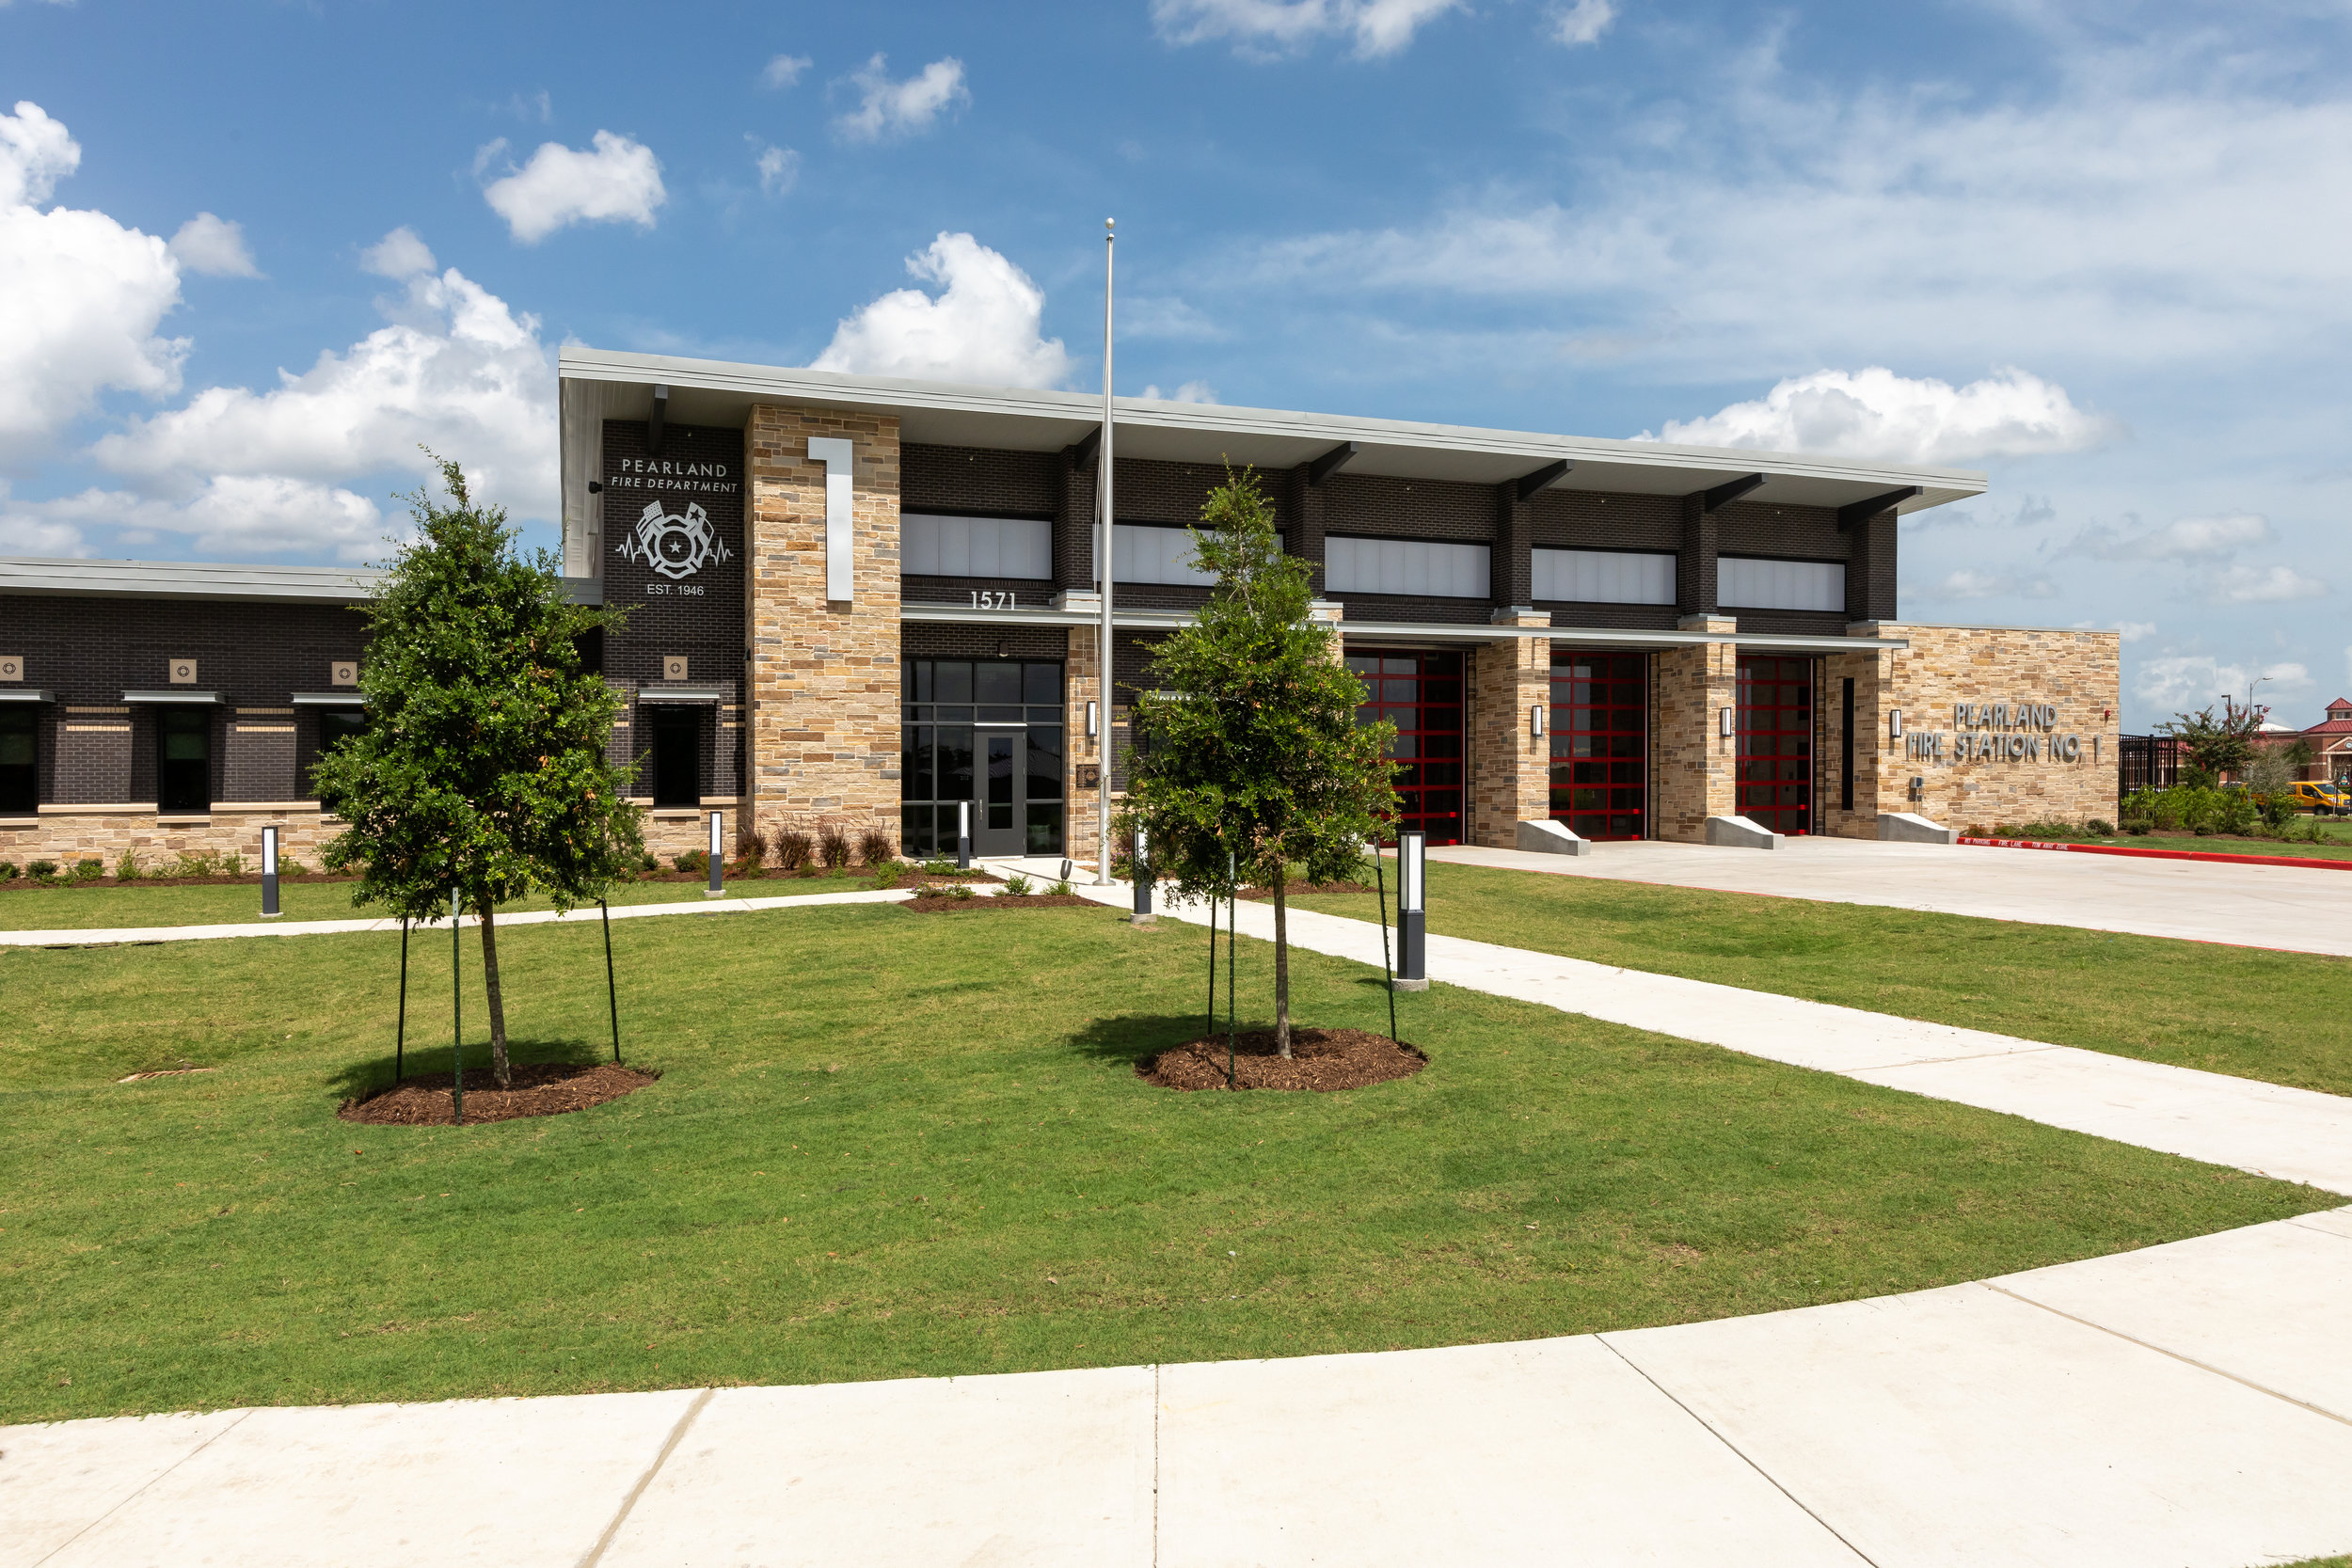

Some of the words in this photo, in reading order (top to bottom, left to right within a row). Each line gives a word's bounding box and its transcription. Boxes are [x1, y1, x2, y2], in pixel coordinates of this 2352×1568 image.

[622, 458, 727, 477] PEARLAND
[612, 477, 641, 487] FIRE
[647, 479, 737, 493] DEPARTMENT
[807, 436, 853, 601] 1
[647, 584, 674, 594] EST.
[677, 585, 704, 596] 1946
[971, 591, 1015, 610] 1571
[1956, 703, 2058, 726] PEARLAND
[1907, 732, 1946, 755] FIRE
[1955, 733, 2041, 756] STATION
